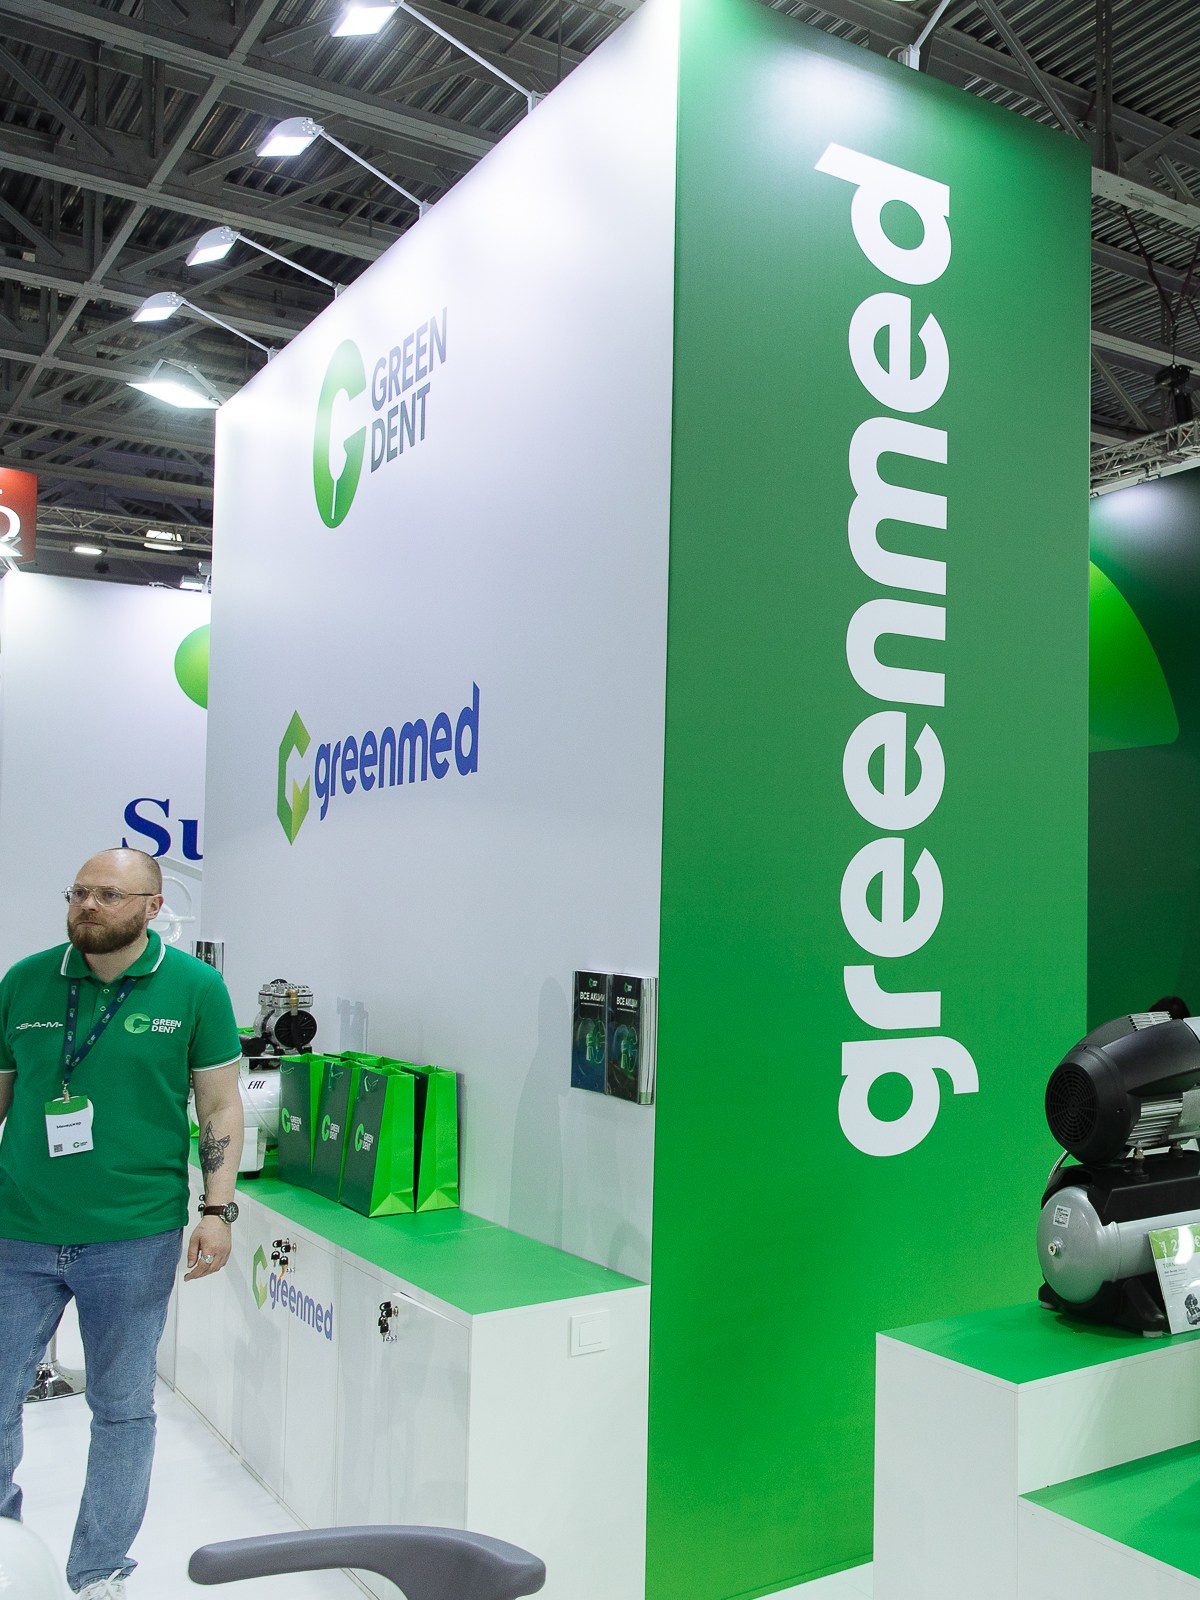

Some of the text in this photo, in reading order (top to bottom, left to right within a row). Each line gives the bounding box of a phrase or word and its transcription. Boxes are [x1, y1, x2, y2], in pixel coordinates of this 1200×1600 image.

[371, 306, 448, 412] GREEN
[370, 382, 431, 473] DENT
[813, 142, 979, 1157] greenmed
[314, 681, 480, 822] greenmed
[151, 1024, 176, 1034] DENT
[152, 1018, 182, 1028] GREEN
[580, 991, 590, 1000] ВСЕ
[616, 996, 625, 1006] ВСЕ
[269, 1272, 334, 1341] greenmed
